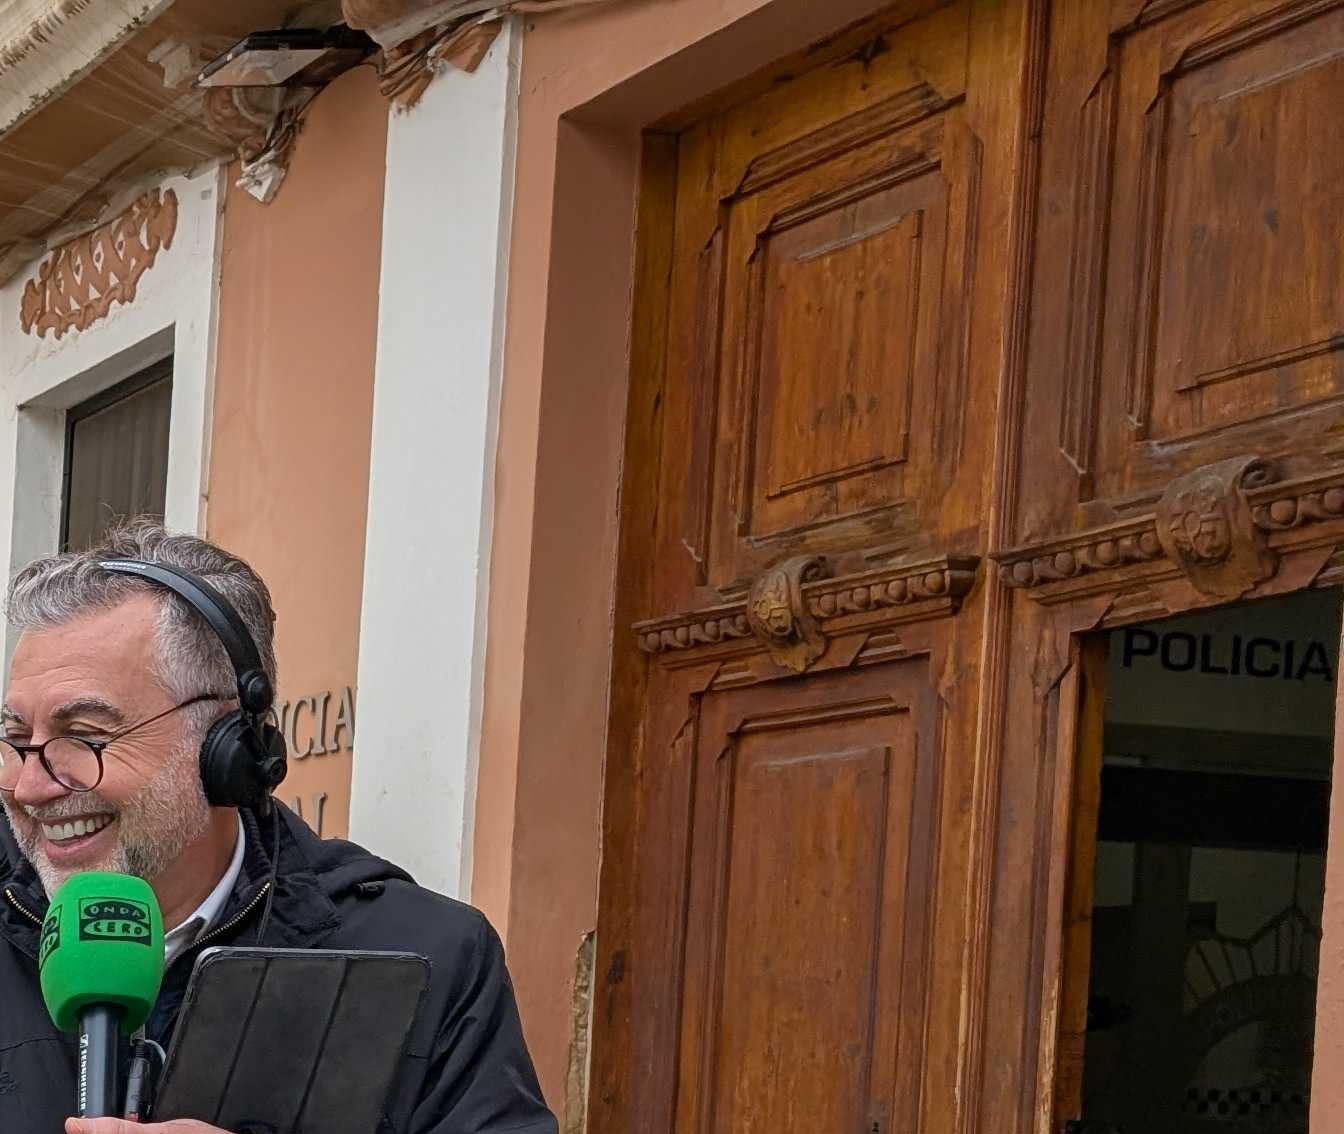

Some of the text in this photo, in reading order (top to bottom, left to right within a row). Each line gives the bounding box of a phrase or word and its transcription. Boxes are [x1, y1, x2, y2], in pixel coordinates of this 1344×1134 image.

[1122, 628, 1334, 683] POLICIA
[90, 905, 142, 918] ONDA
[93, 921, 143, 935] CERO
